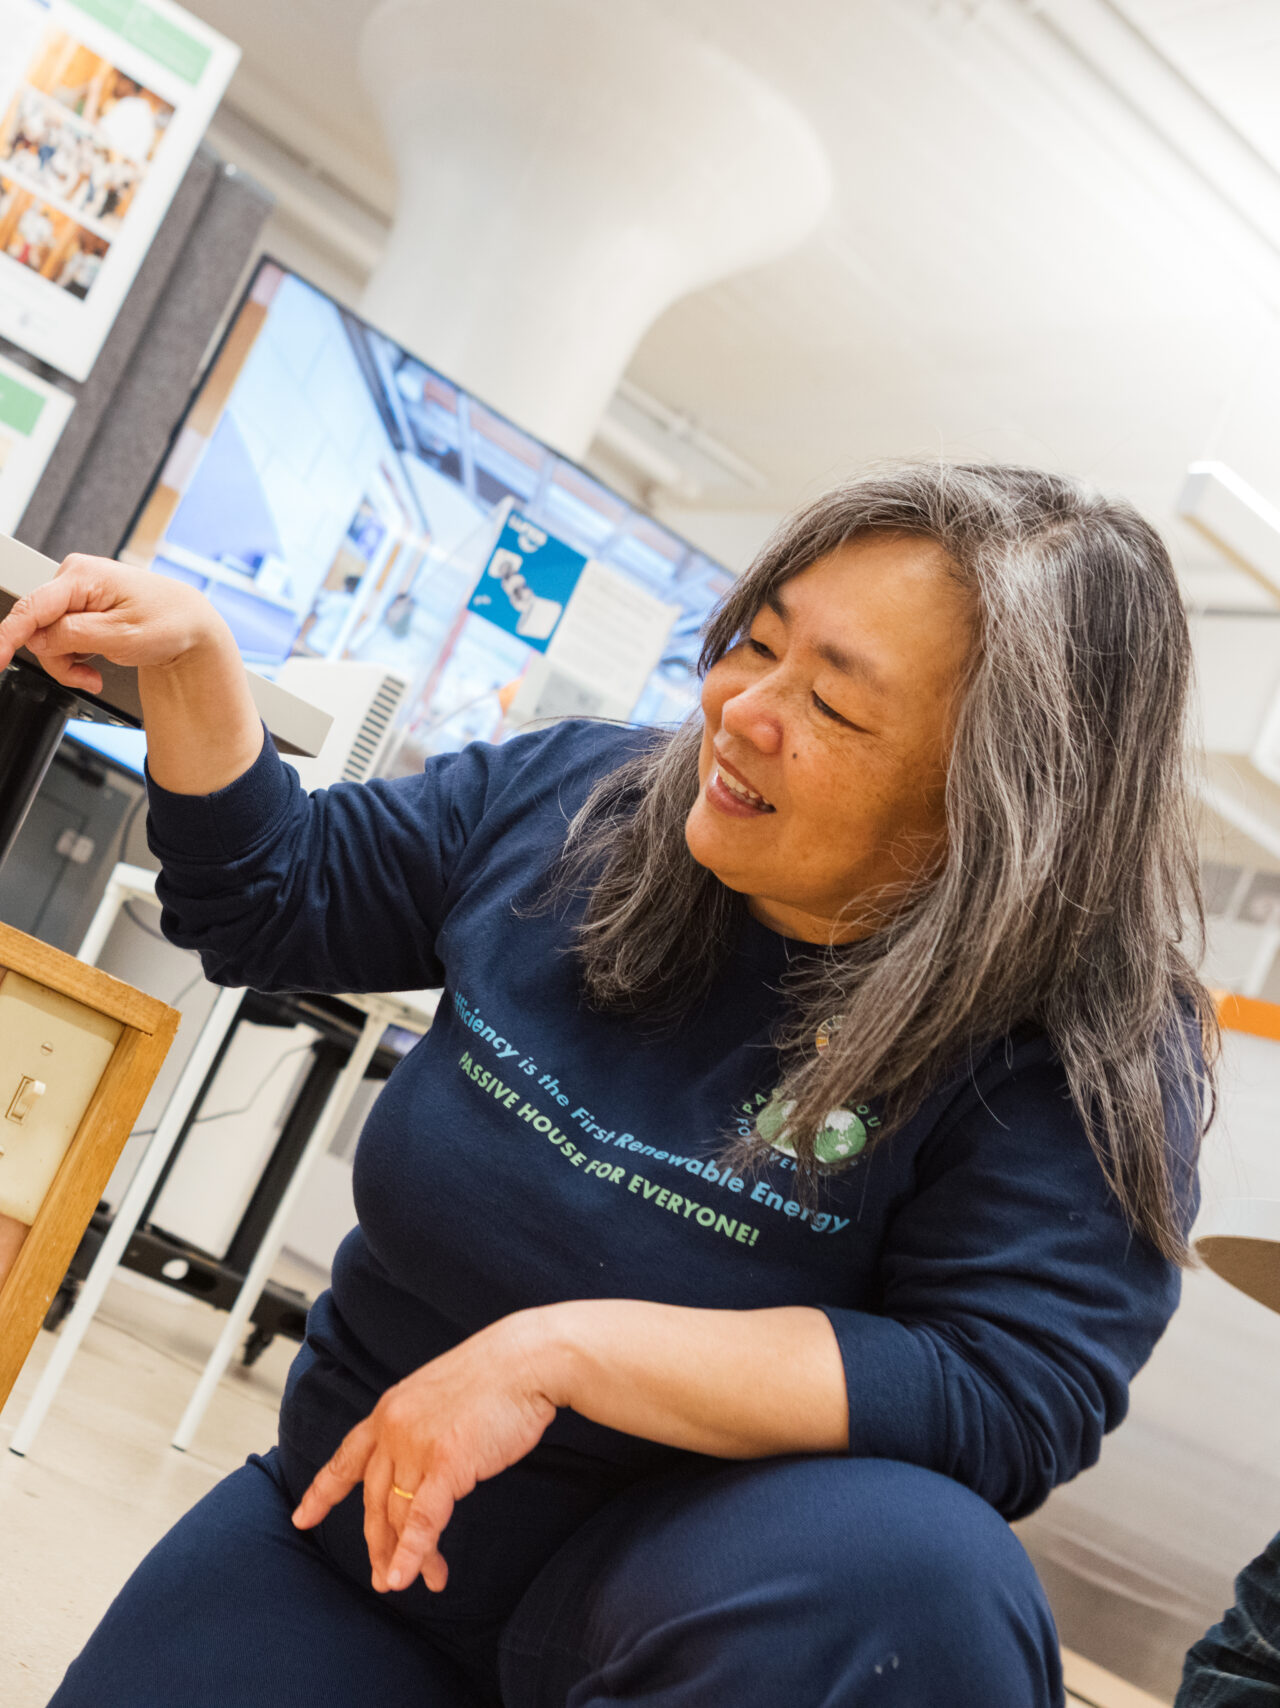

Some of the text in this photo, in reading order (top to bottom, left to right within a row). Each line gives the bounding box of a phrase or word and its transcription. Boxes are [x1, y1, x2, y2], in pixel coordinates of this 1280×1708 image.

[455, 992, 519, 1058] fficiency
[518, 1057, 538, 1076] is
[538, 1074, 569, 1107] the
[570, 1106, 615, 1143] First
[614, 1133, 745, 1193] Renewable
[750, 1181, 850, 1234] Energy
[459, 1051, 760, 1247] PASSIVE HOUSE FOR EVERYONE!
